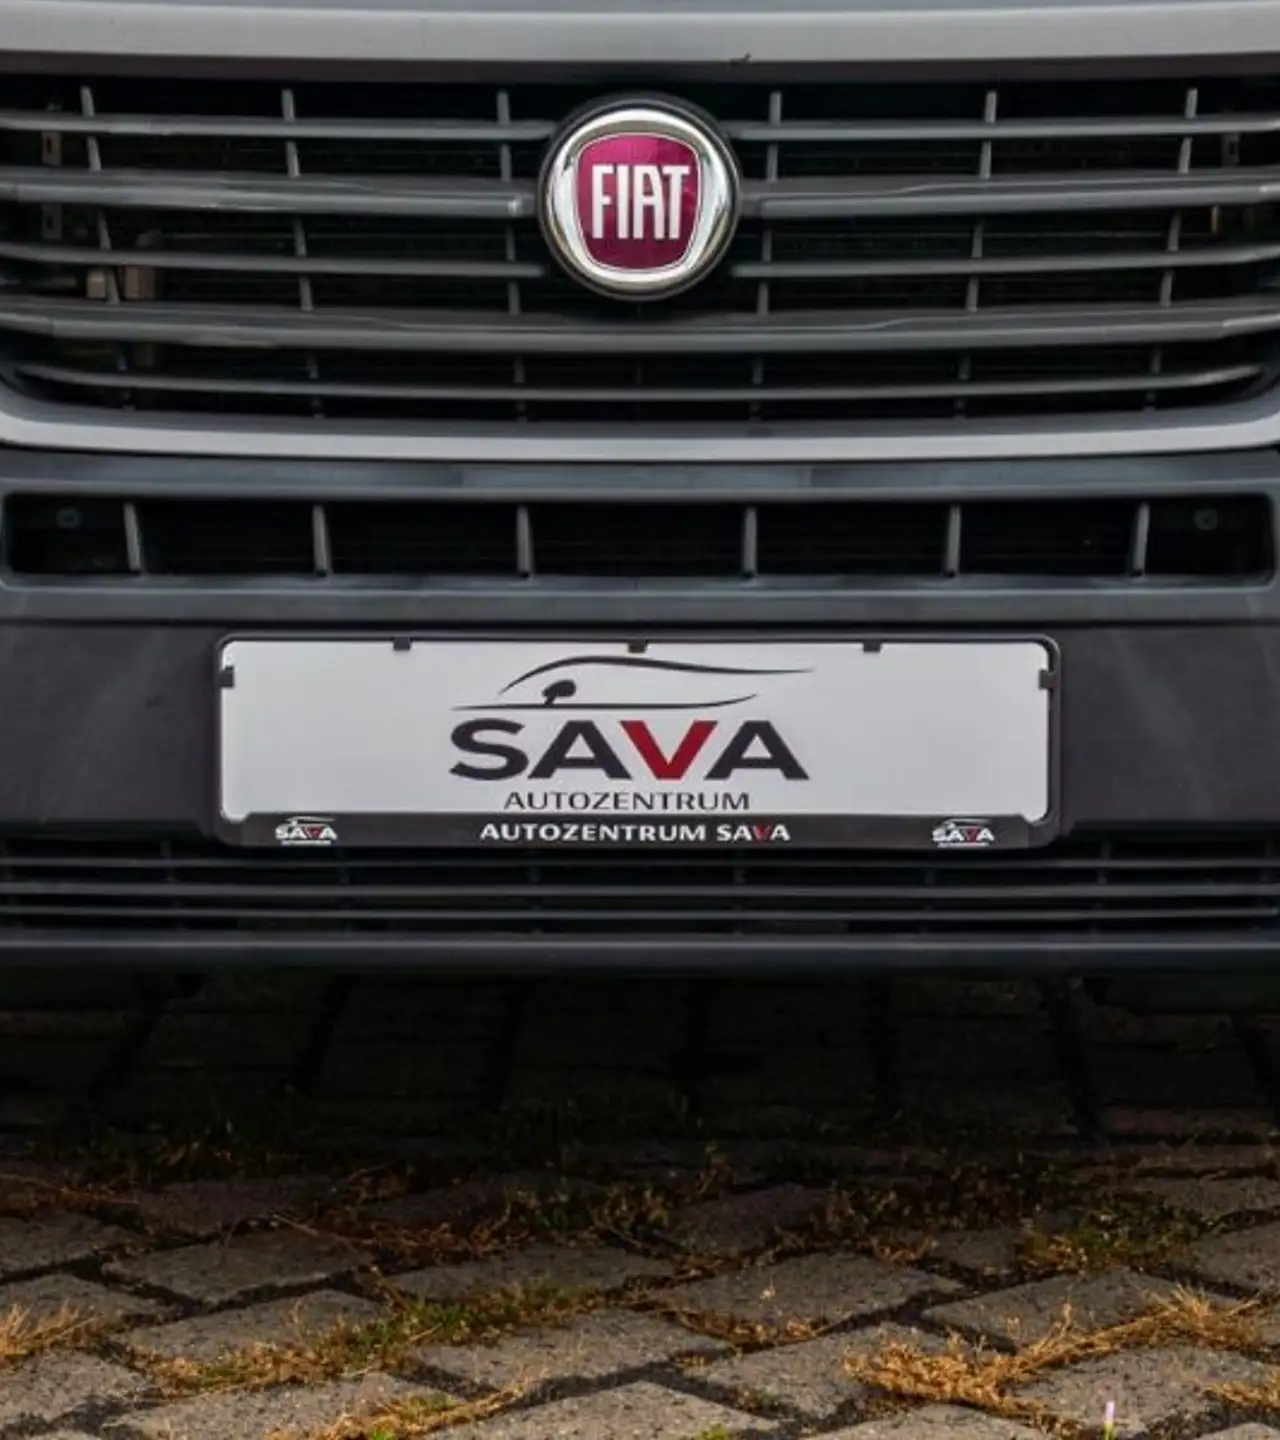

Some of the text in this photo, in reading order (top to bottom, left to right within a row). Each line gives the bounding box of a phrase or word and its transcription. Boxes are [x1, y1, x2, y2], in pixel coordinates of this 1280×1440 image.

[591, 164, 691, 240] FIAT
[449, 718, 810, 781] SAVA
[503, 791, 750, 811] AUTOZENTRUM
[479, 823, 791, 842] AUTOZENTRUM SAVA
